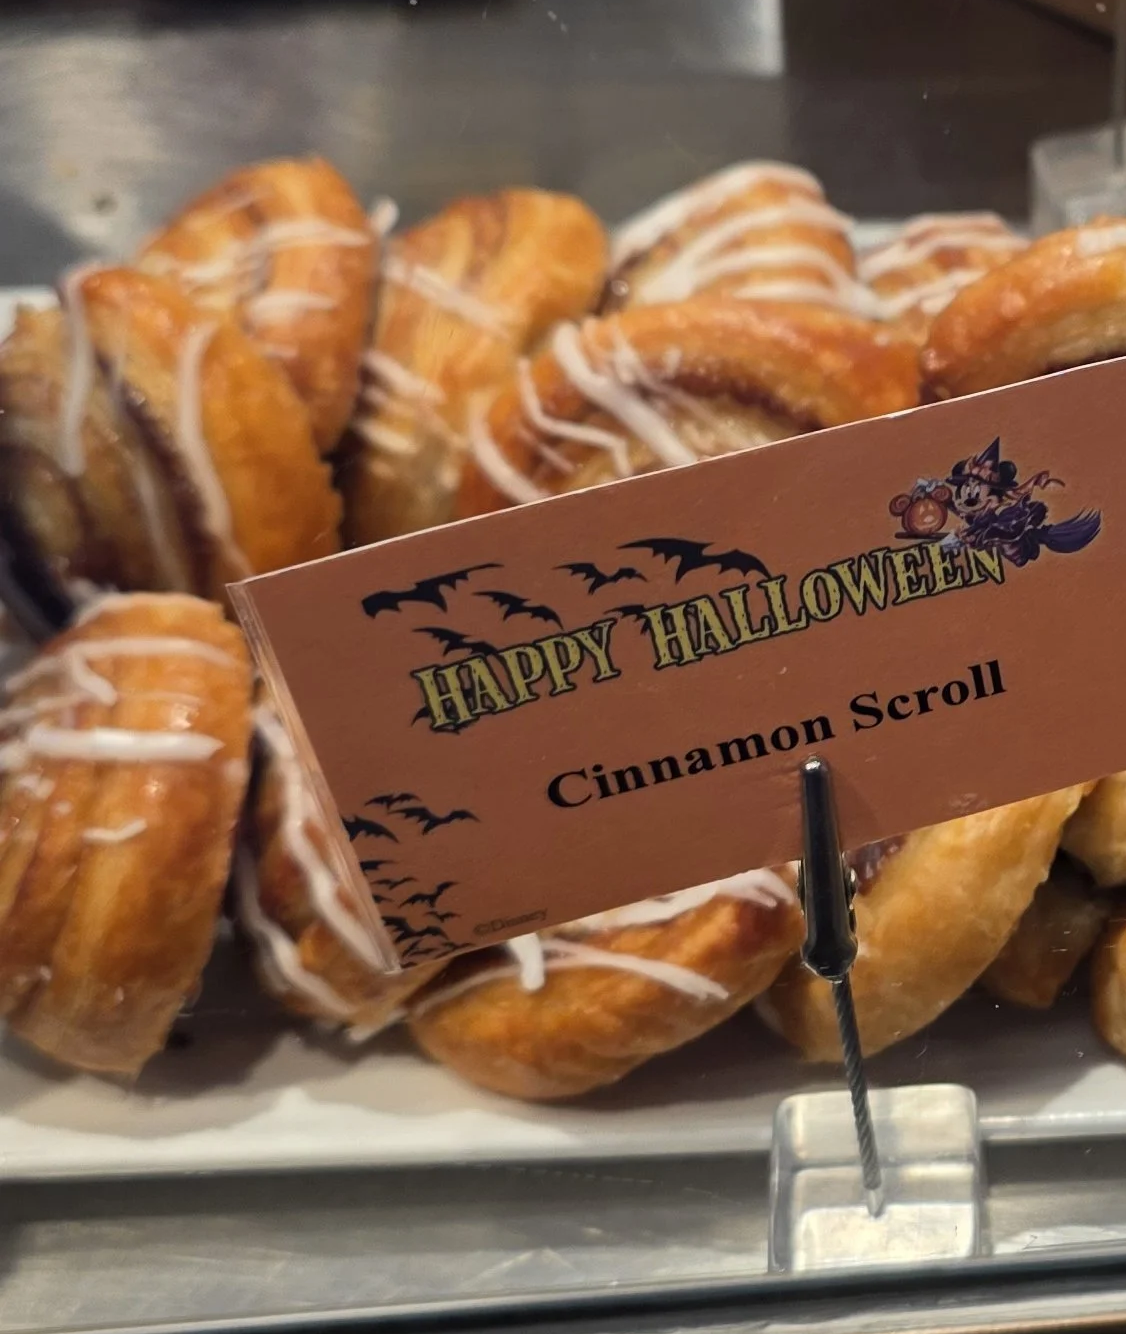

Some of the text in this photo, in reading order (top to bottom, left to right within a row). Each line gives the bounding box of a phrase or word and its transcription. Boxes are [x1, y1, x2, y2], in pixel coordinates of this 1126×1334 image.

[410, 541, 1006, 732] HAPPY HALLOWEEN
[546, 659, 1007, 809] Cinnamon Scroll
